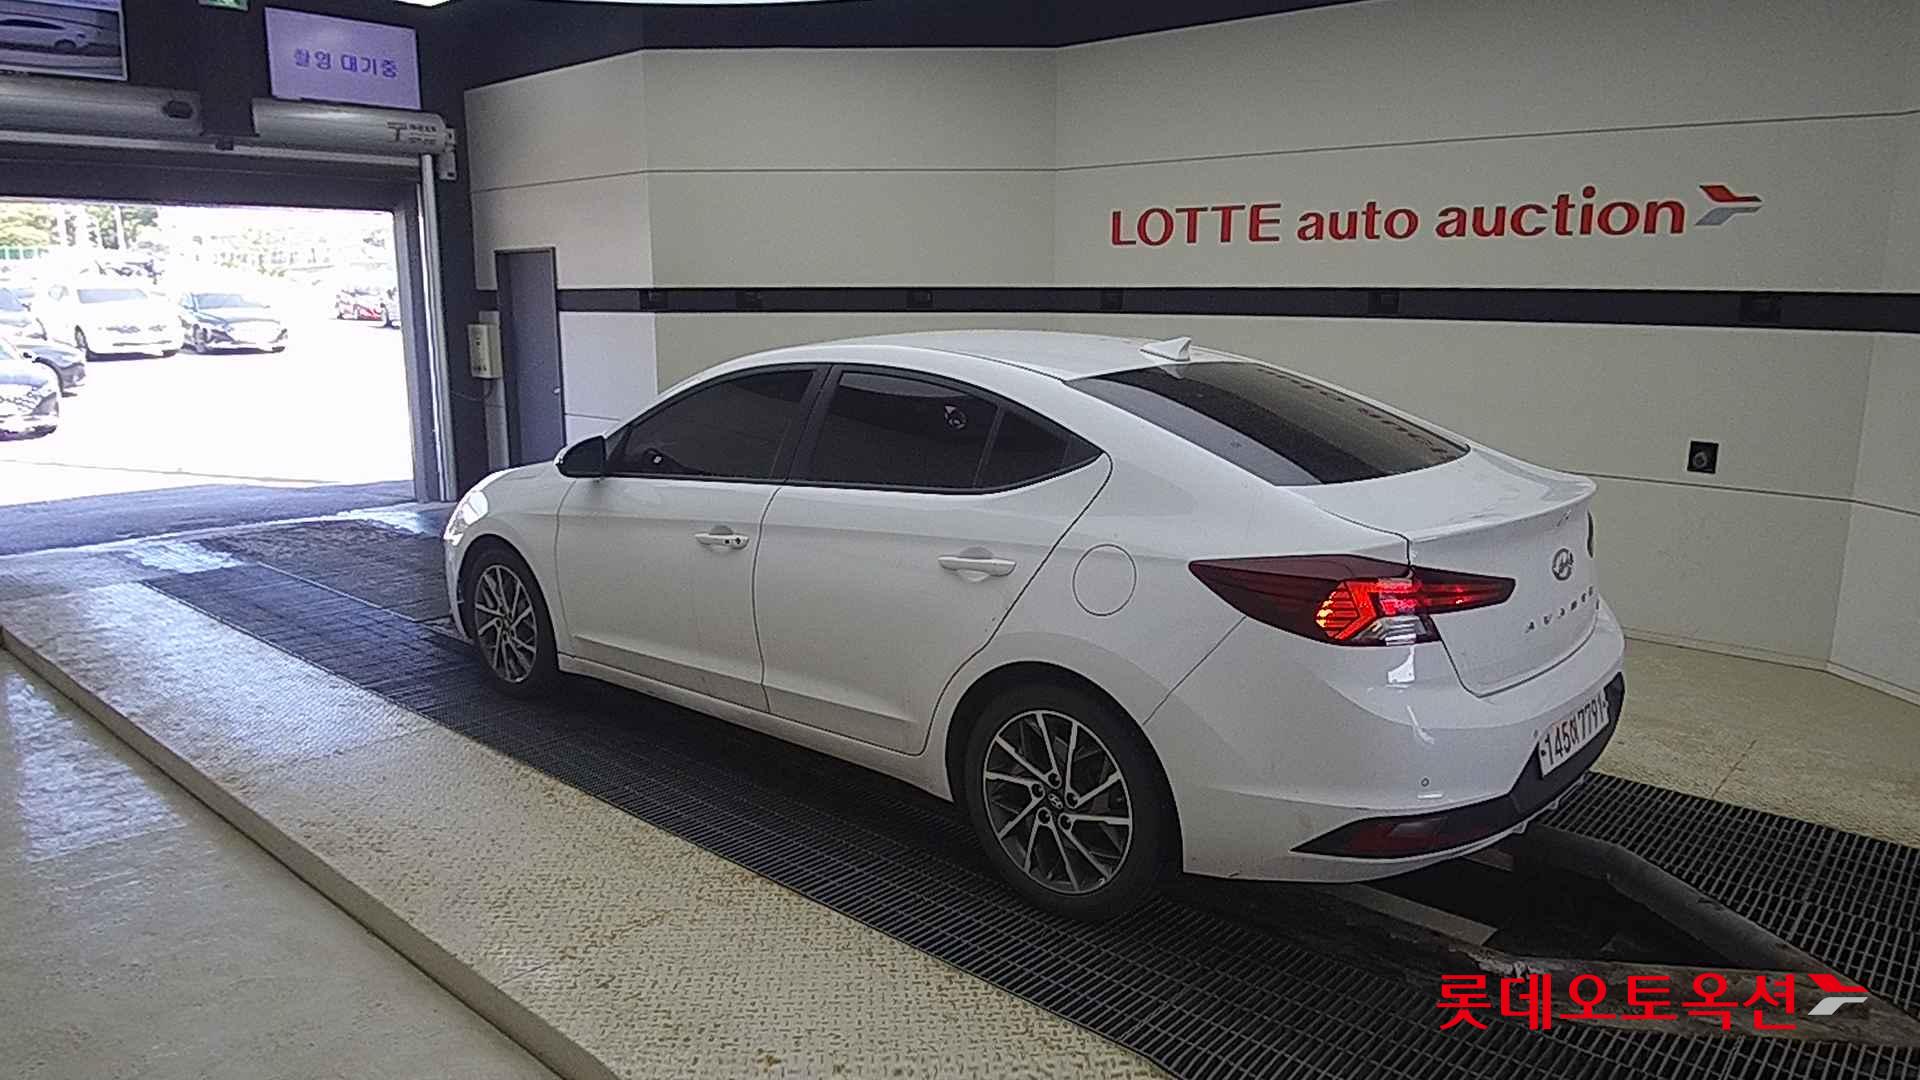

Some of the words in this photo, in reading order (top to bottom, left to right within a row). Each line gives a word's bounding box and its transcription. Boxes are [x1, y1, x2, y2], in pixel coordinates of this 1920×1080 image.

[340, 53, 397, 79] 대기중
[1110, 203, 1280, 246] LOTTE
[1296, 203, 1419, 241] auto
[1437, 186, 1685, 238] auction
